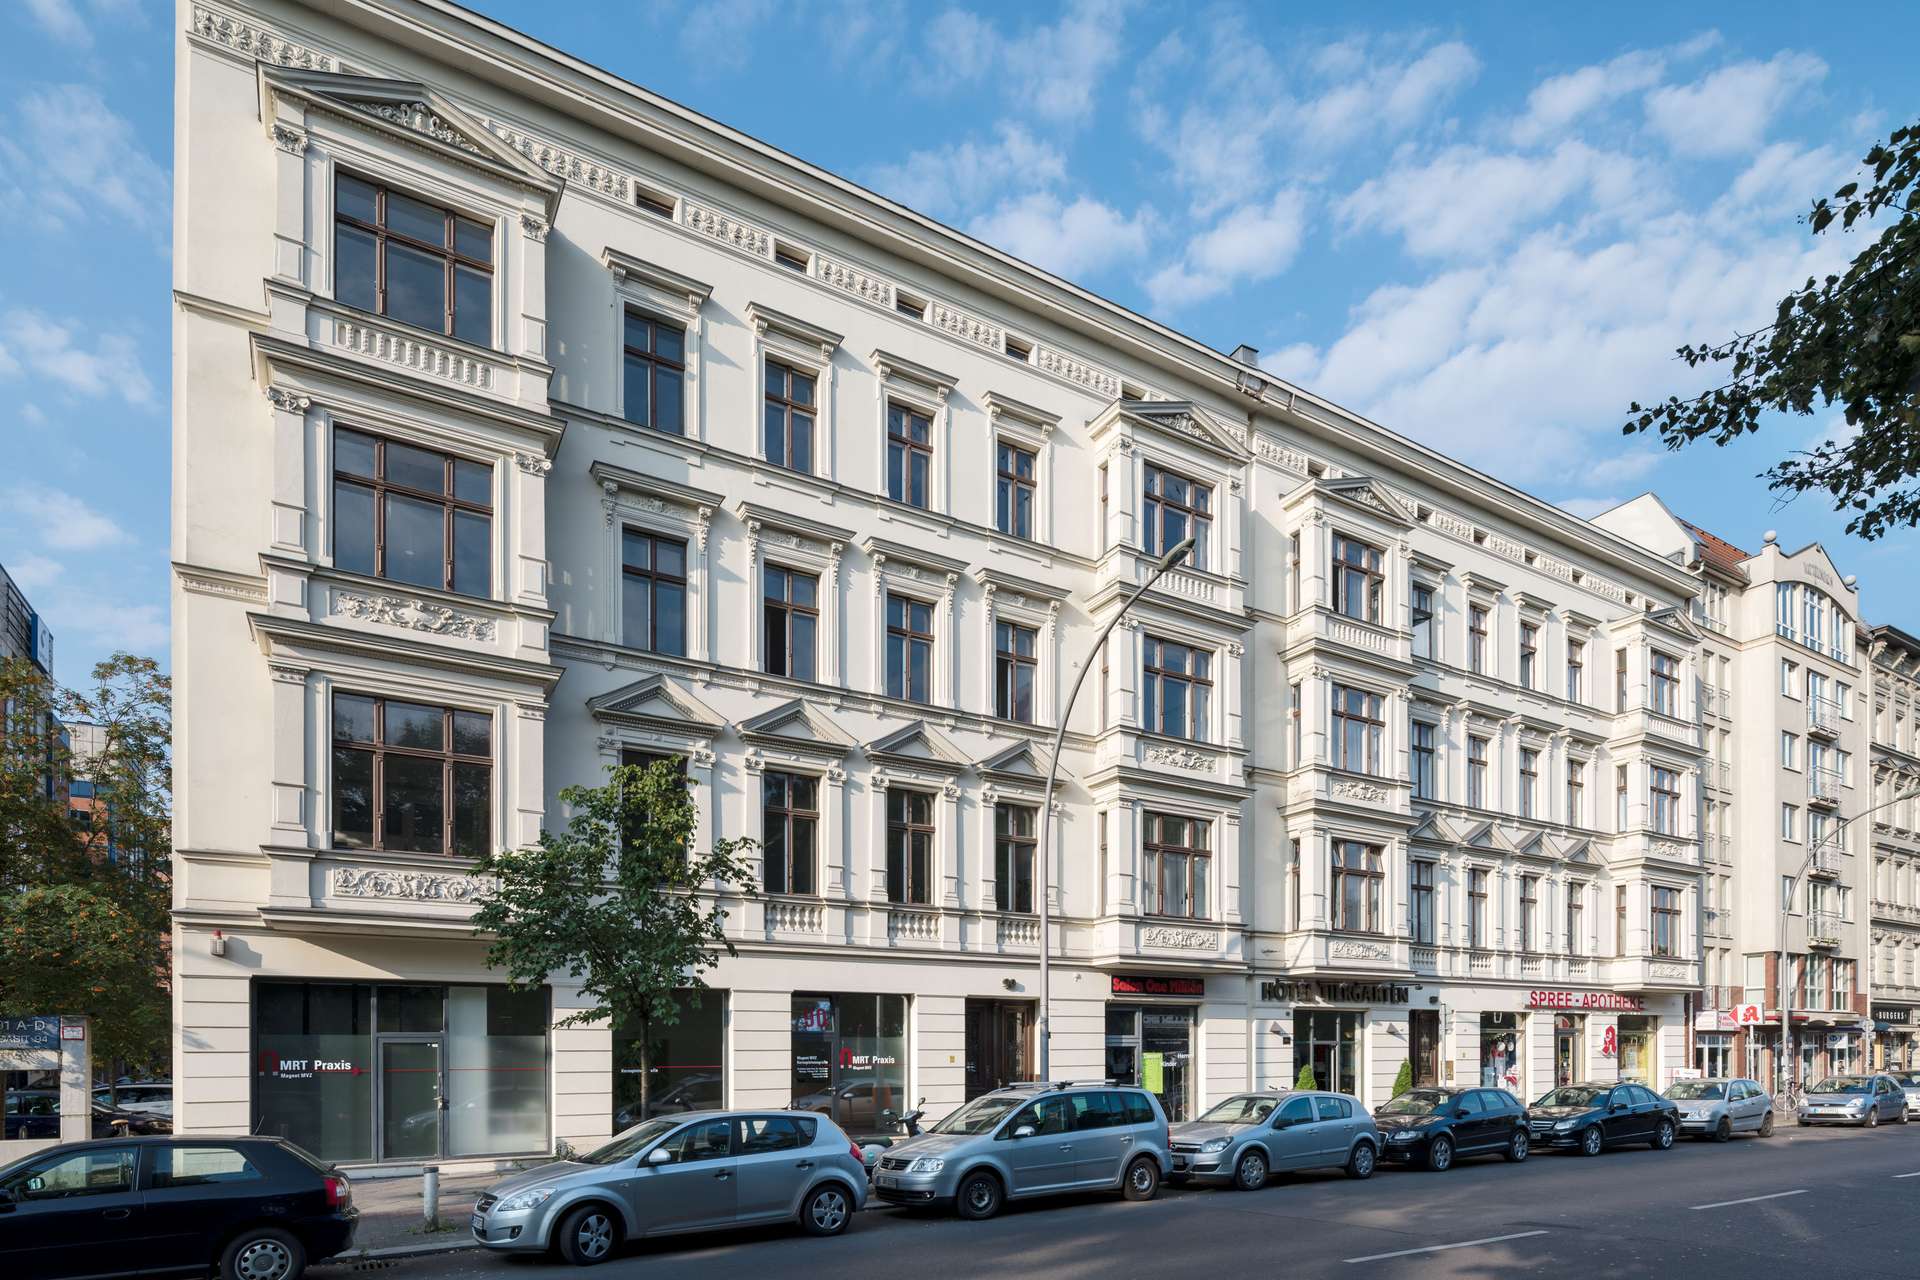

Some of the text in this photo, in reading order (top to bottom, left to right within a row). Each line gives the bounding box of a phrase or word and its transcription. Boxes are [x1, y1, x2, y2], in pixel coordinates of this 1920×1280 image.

[1261, 983, 1311, 1001] HOTEL
[1879, 1011, 1905, 1020] BURGERS
[852, 1055, 895, 1065] MRT Praxis
[280, 1060, 352, 1071] MRT Praxis
